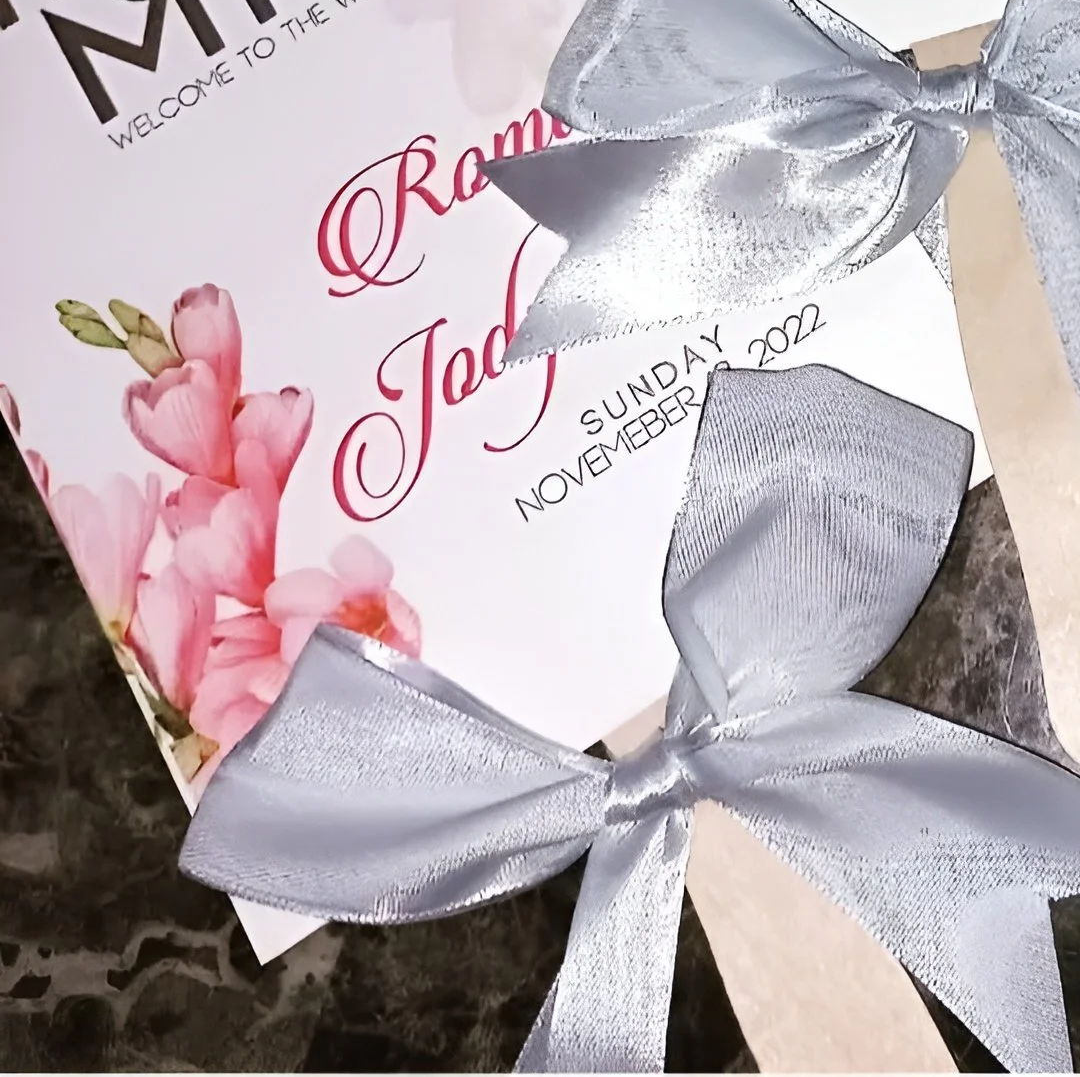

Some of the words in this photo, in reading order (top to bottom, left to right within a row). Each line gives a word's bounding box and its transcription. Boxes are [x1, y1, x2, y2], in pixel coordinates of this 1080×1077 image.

[107, 62, 235, 150] WELCOME
[237, 36, 276, 68] TO
[280, 2, 330, 41] THE
[514, 386, 703, 523] NOVEMEBER
[748, 303, 827, 367] 2022
[580, 324, 723, 437] SUNDAY
